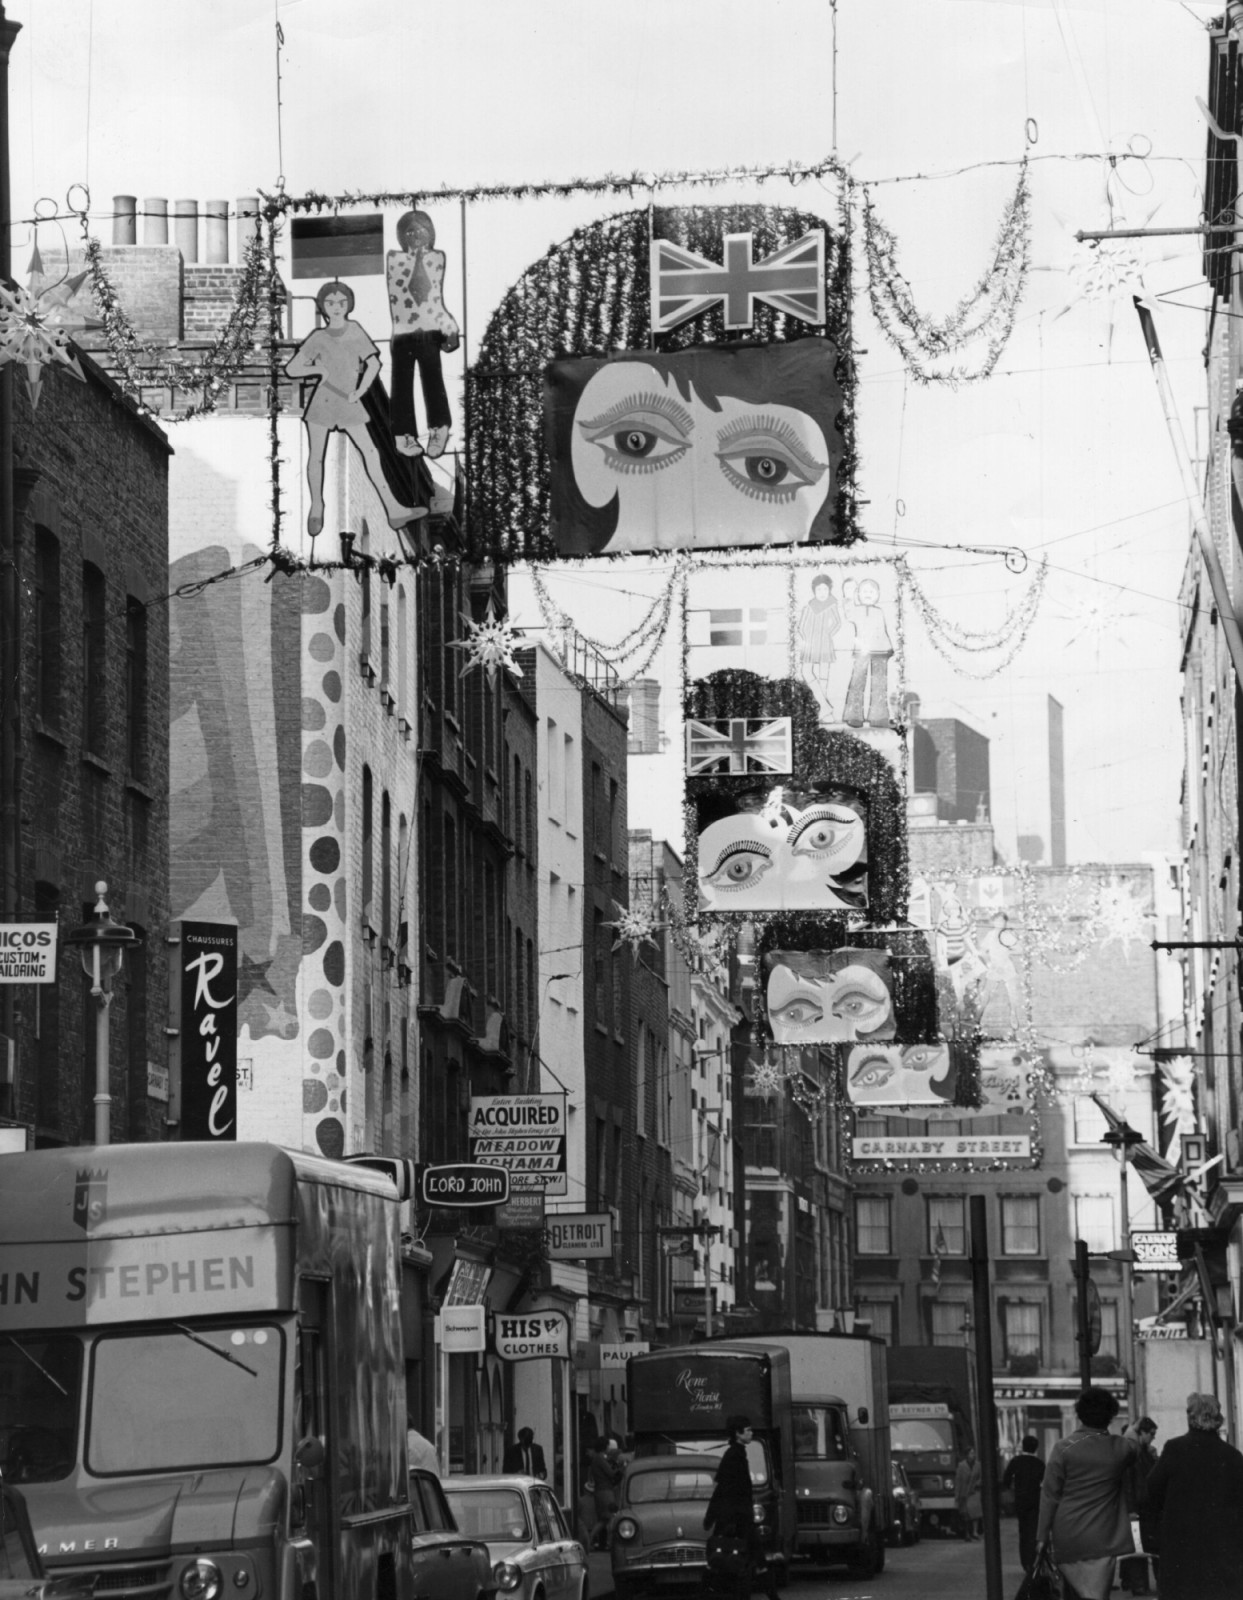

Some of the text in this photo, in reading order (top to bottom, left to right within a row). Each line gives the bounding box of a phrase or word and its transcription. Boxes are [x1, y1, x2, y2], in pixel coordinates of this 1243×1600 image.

[186, 934, 234, 947] CHAUSSURES
[185, 951, 235, 1136] Ravel
[474, 1106, 559, 1126] ACQUIRED
[477, 1139, 555, 1152] MEADOW
[860, 1141, 1023, 1154] CARNABY STREET
[428, 1176, 465, 1192] LORD
[468, 1177, 502, 1192] JOHN
[552, 1223, 606, 1249] DETROIT
[66, 1256, 254, 1302] STEPHEN
[501, 1319, 541, 1338] HIS
[503, 1343, 559, 1354] CLOTHES
